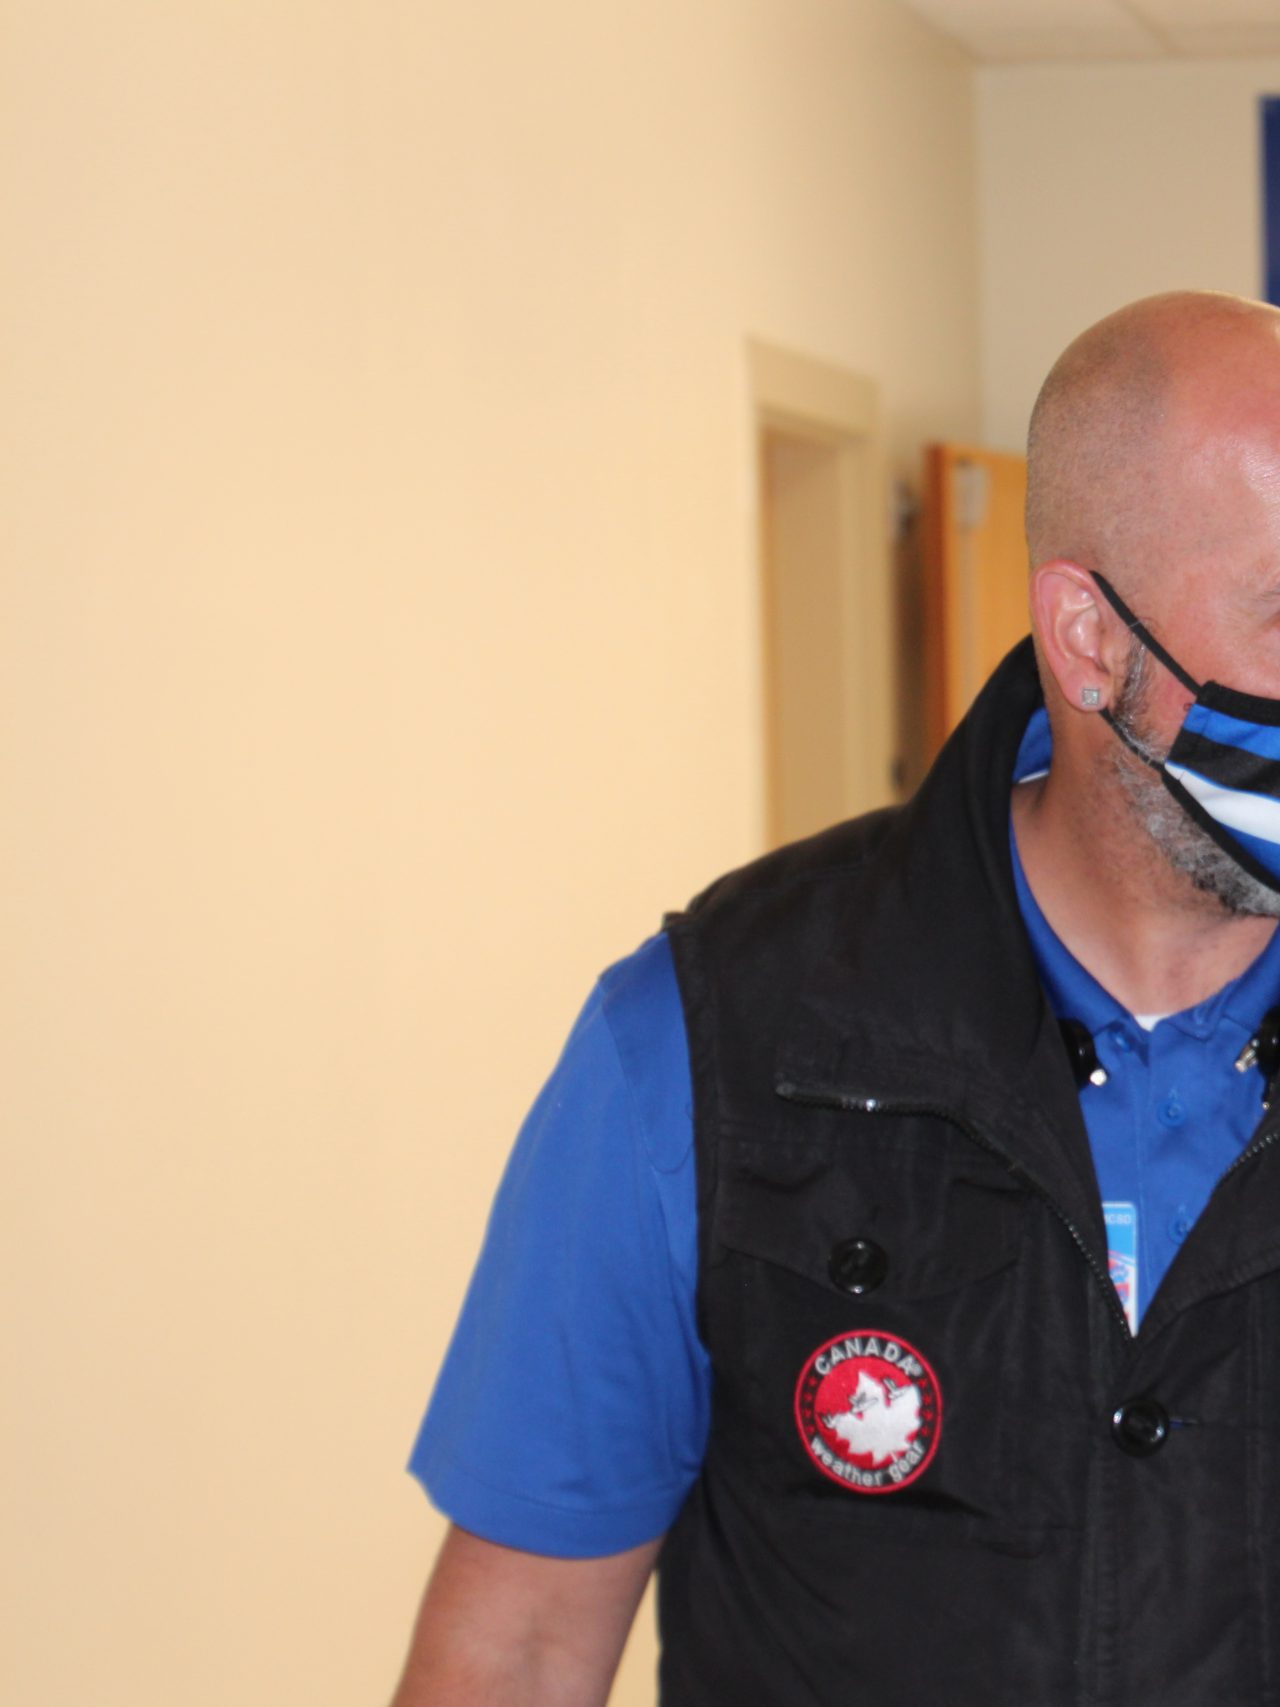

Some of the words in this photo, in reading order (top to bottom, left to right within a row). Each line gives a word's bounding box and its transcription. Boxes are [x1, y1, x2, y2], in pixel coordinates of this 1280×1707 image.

[814, 1337, 920, 1376] CANADA
[810, 1436, 884, 1487] weather
[888, 1440, 925, 1483] gear
